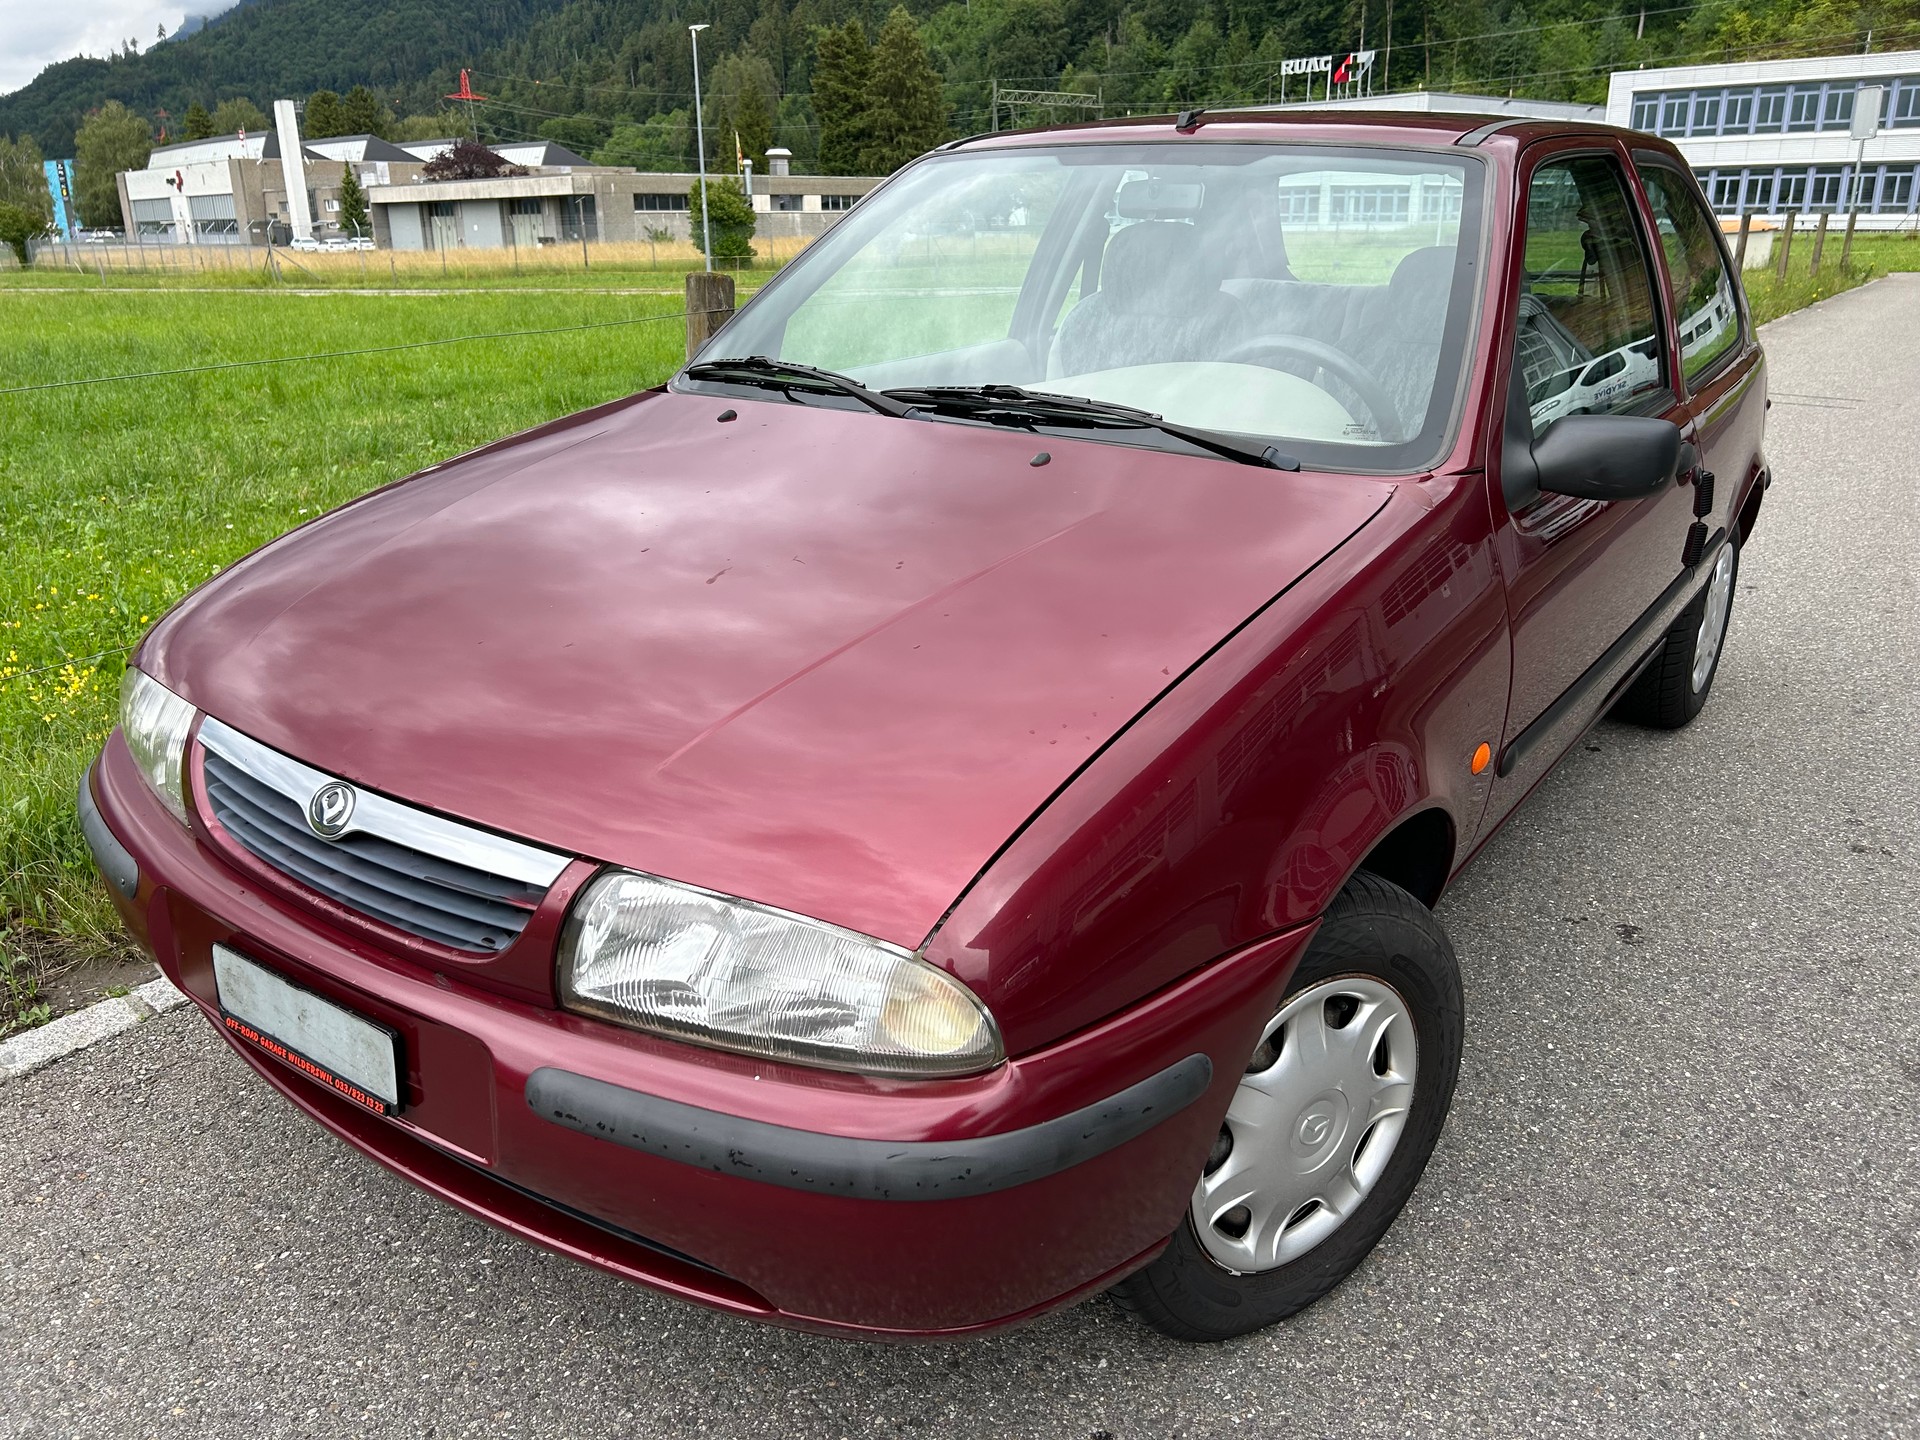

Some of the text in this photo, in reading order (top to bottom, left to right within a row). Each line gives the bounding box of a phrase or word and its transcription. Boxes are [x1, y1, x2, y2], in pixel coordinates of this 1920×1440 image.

[1281, 56, 1332, 75] RUAG
[226, 1017, 385, 1113] OFF-ROAD GARAGE WILDERSWIL 033/823 13 23
